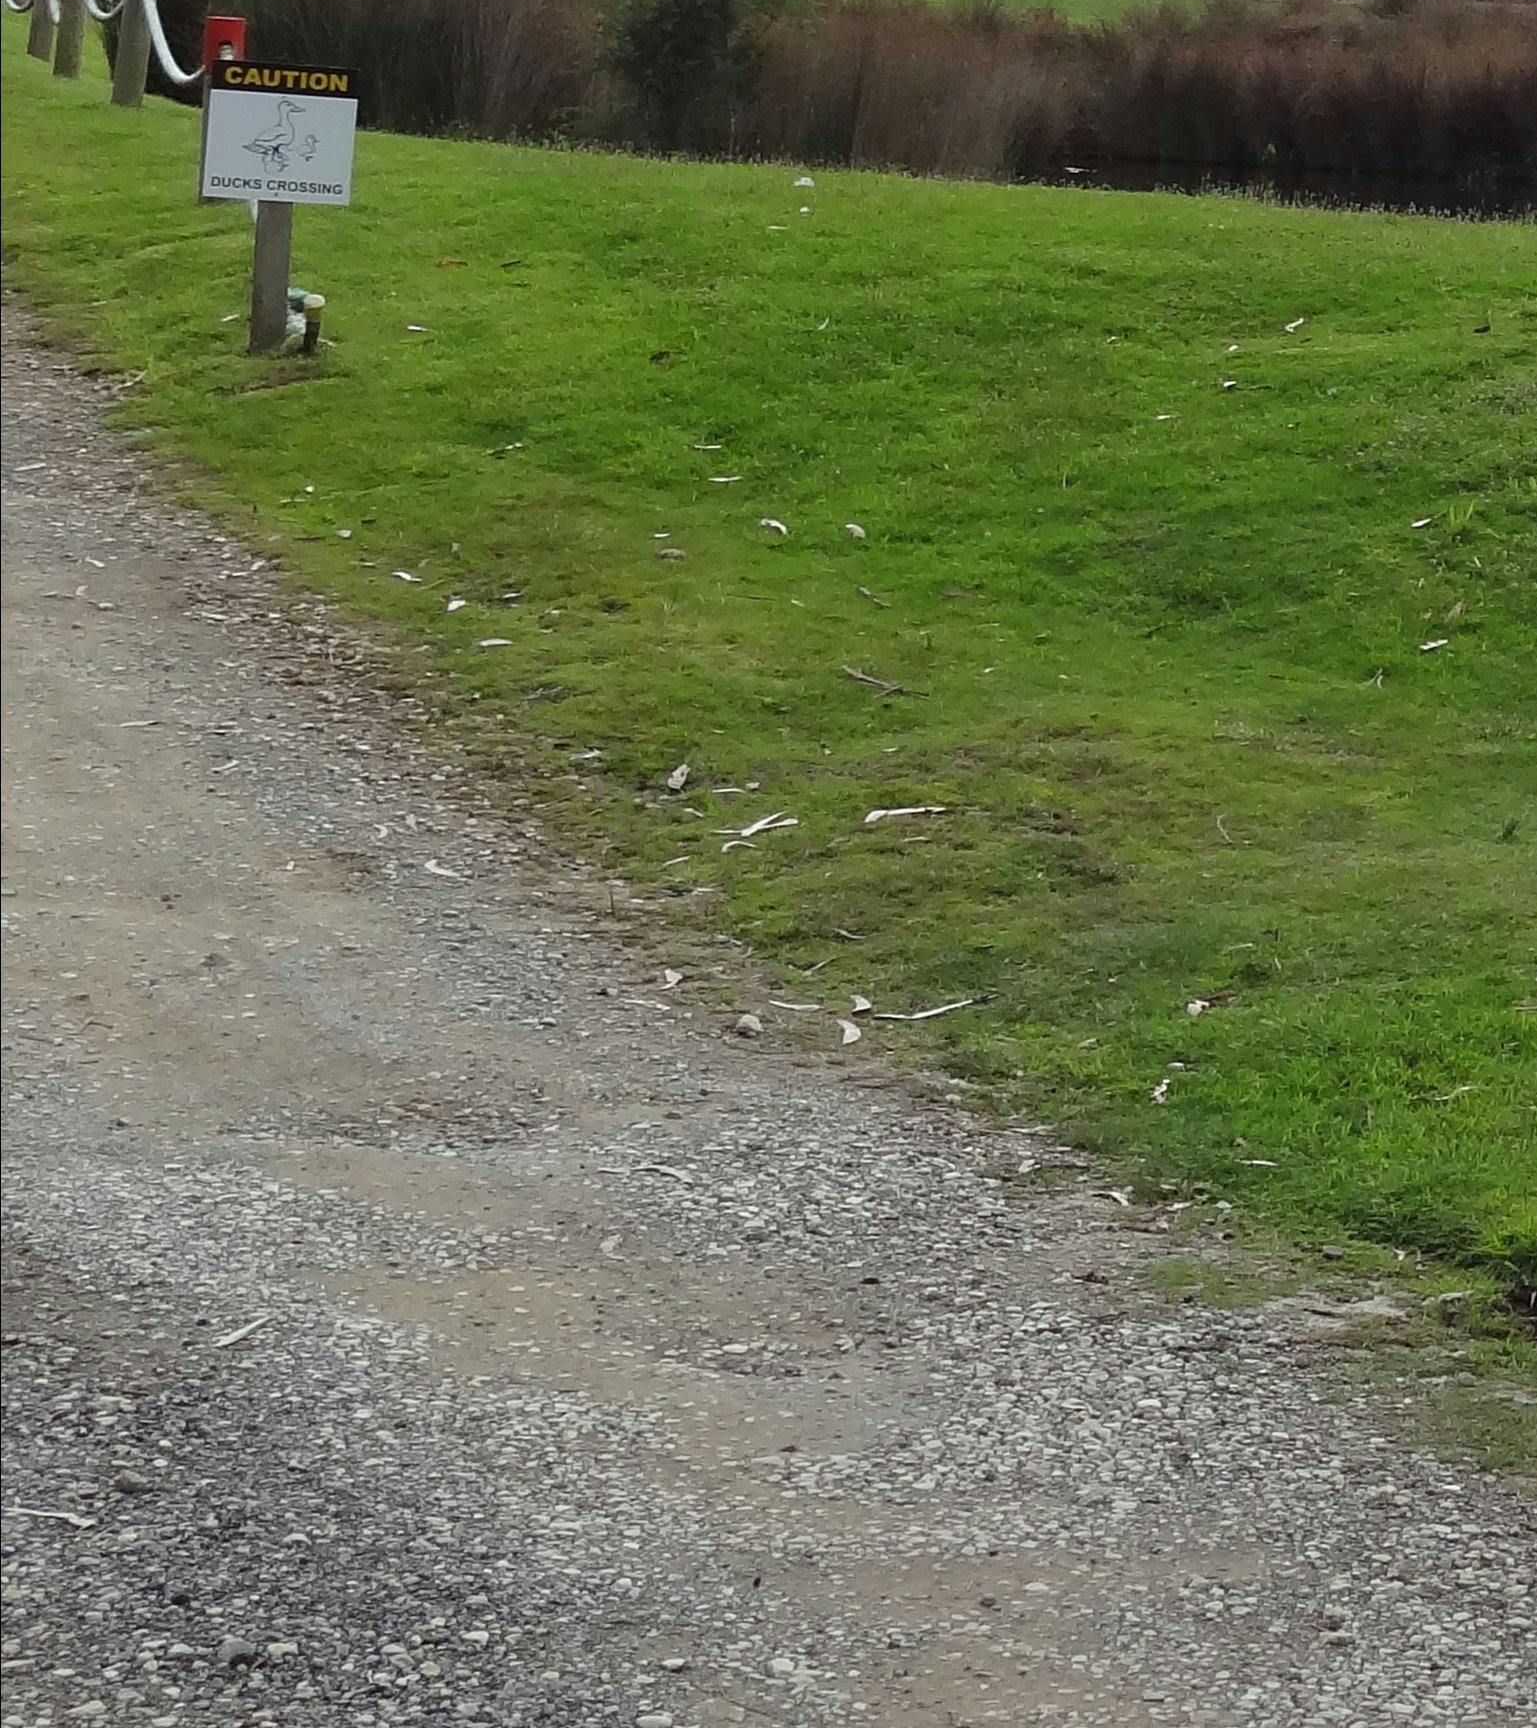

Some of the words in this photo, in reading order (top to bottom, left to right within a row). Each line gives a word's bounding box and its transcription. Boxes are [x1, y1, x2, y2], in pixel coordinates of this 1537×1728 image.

[224, 66, 348, 92] CAUTION
[211, 176, 262, 190] DUCKS
[266, 179, 343, 195] CROSSING
